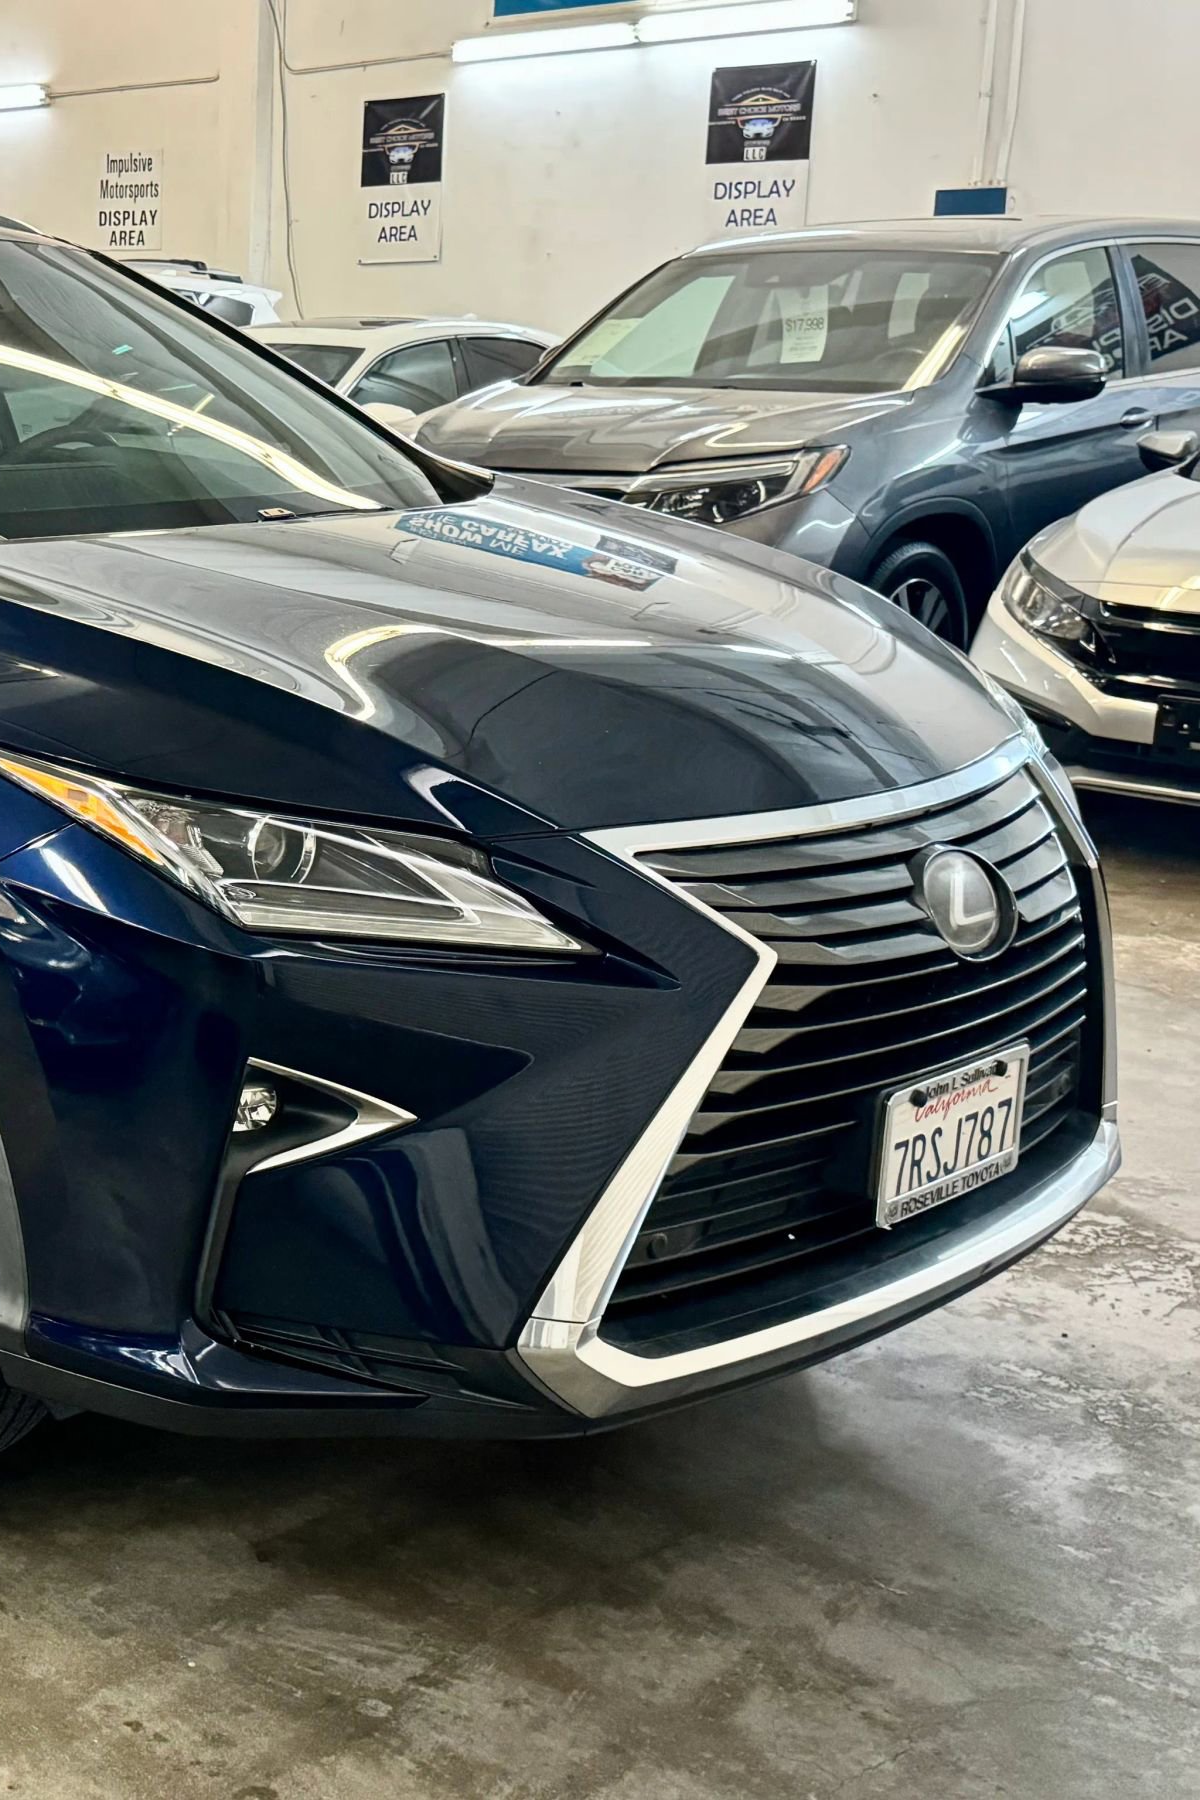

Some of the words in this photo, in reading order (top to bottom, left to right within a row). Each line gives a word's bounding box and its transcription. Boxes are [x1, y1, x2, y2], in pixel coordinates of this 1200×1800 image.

[106, 152, 152, 178] Impulsive
[100, 179, 159, 204] Motorsports
[713, 179, 796, 200] DISPLAY
[99, 209, 158, 226] DISPLAY
[368, 199, 431, 219] DISPLAY
[725, 207, 778, 227] AREA
[109, 230, 145, 246] AREA
[377, 225, 418, 243] AREA
[914, 1079, 998, 1122] California
[894, 1096, 1013, 1197] 7RSJ787
[900, 1182, 959, 1218] ROSEVILLE
[960, 1162, 1000, 1191] TOYOTA
